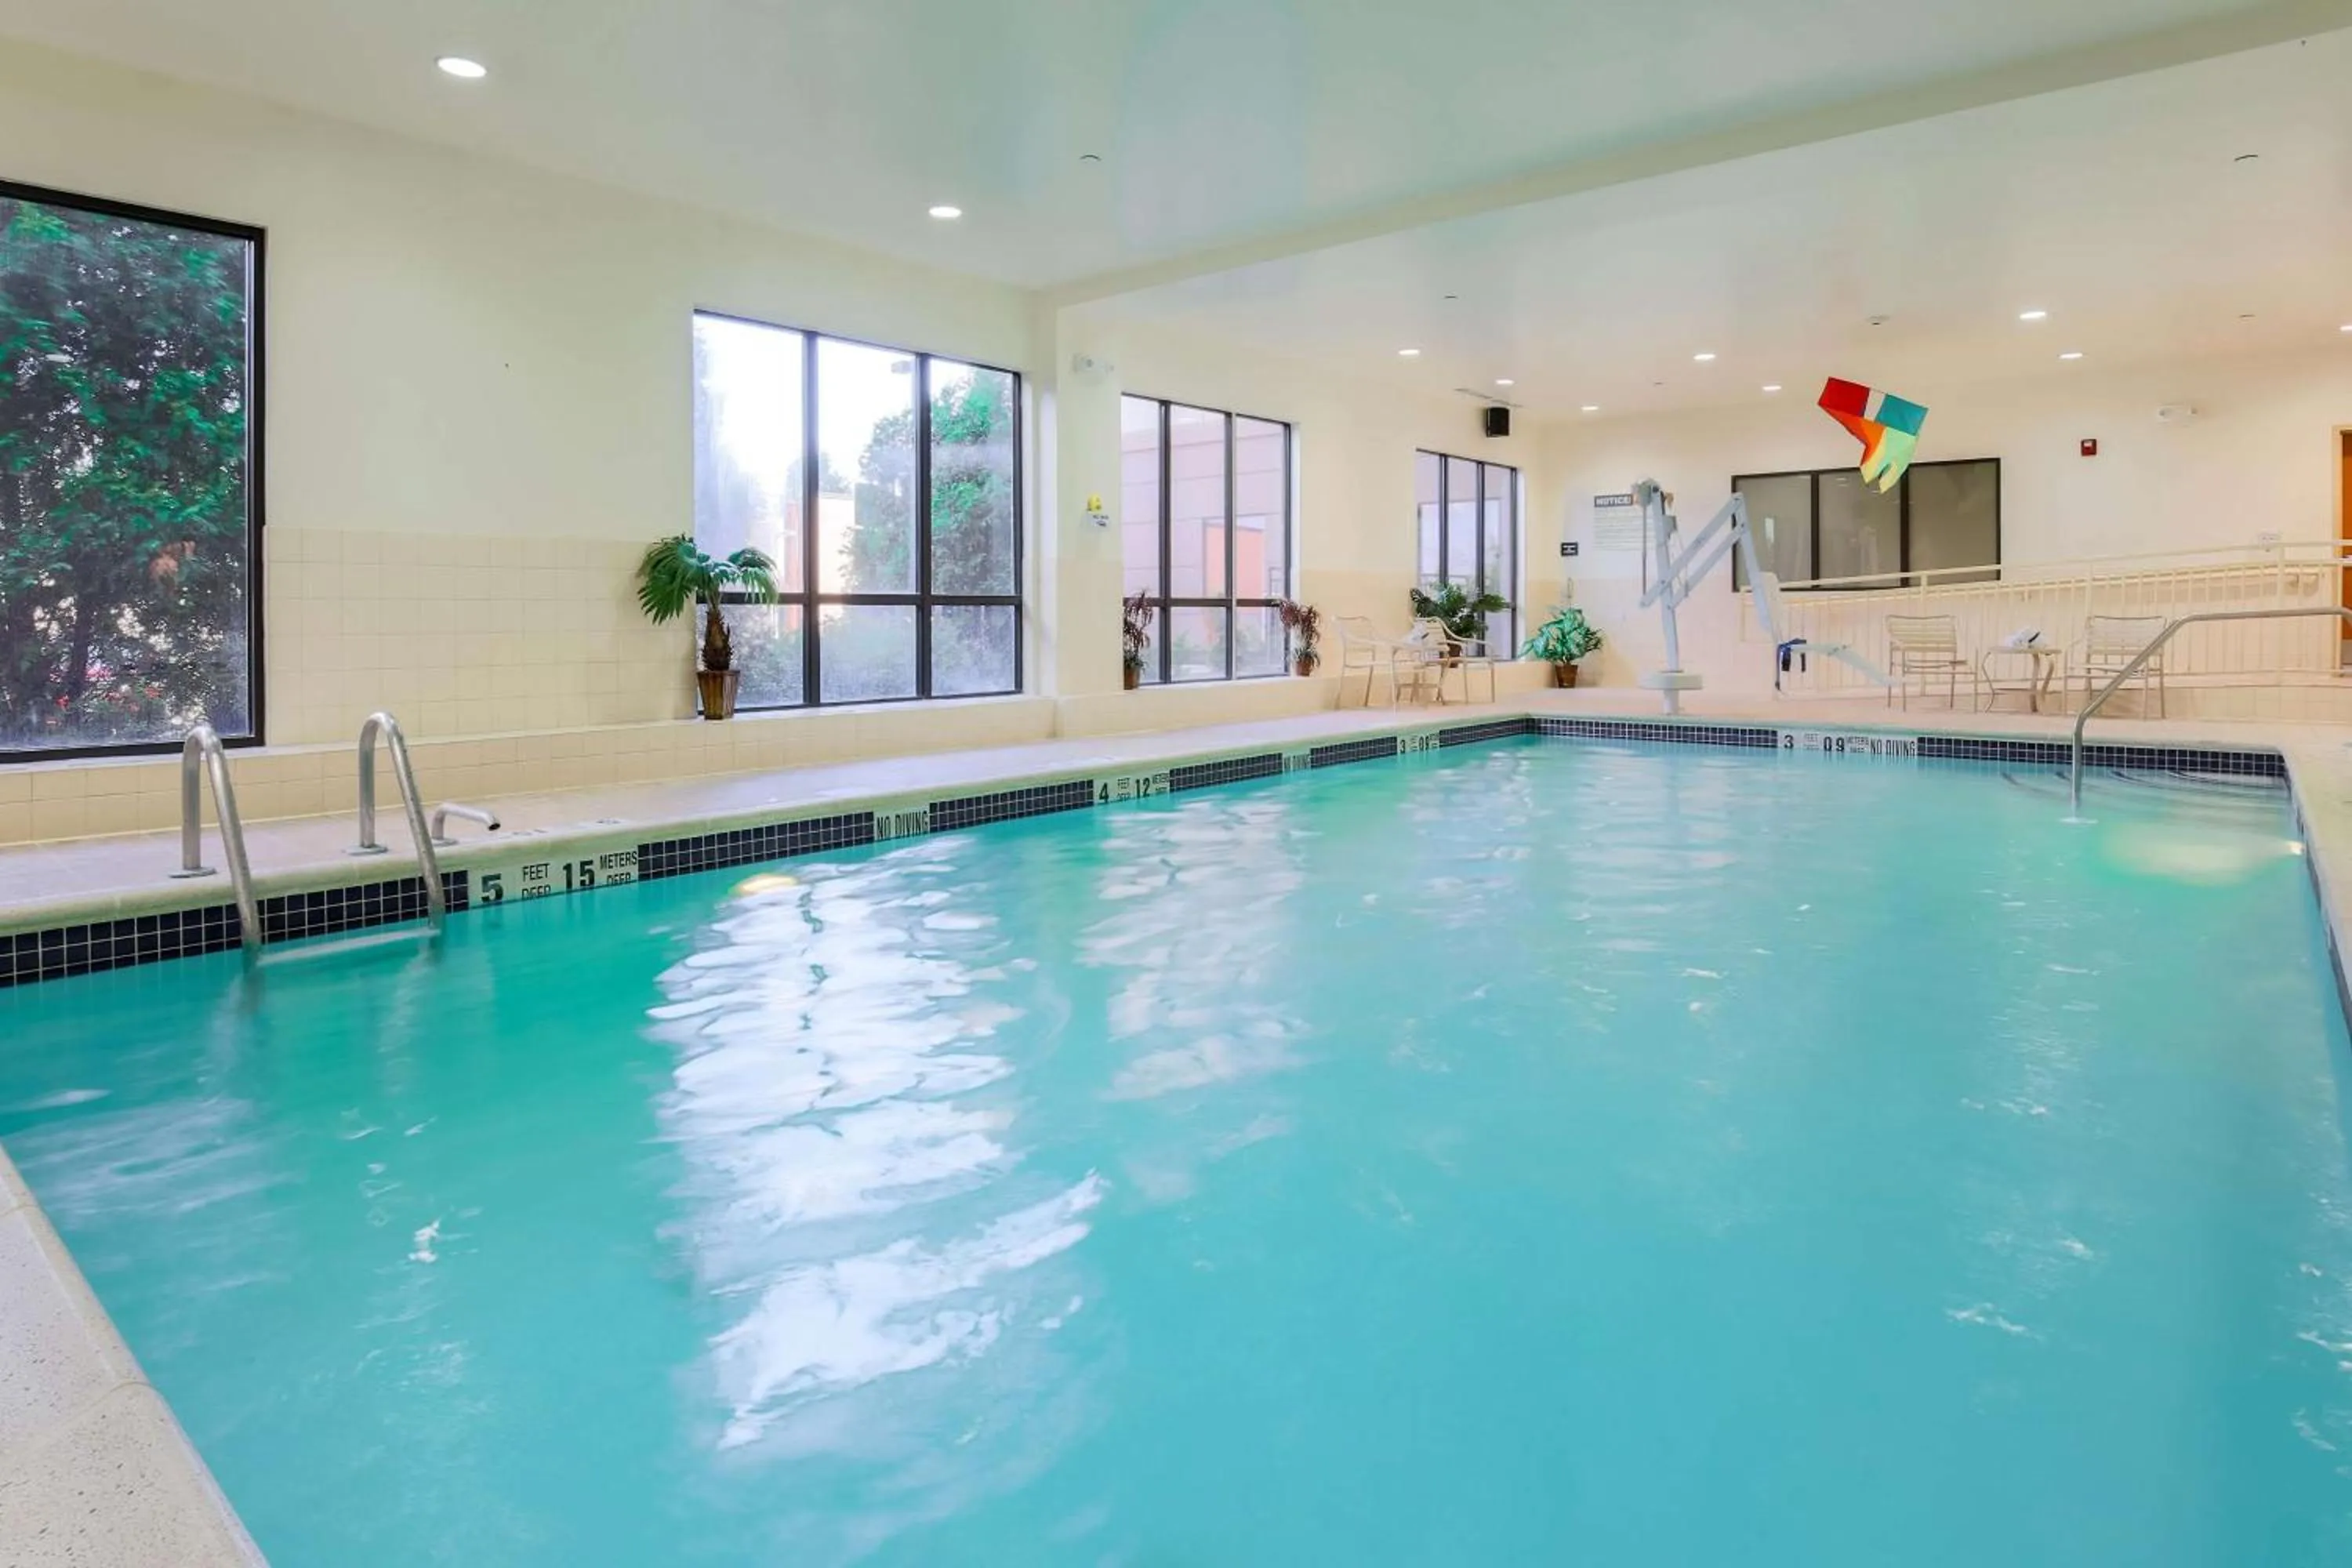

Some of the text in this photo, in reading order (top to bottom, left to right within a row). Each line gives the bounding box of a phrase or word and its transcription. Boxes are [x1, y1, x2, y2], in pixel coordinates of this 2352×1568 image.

[1399, 739, 1406, 753] 3
[1784, 735, 1794, 749] 3
[1871, 739, 1882, 754] NO
[1886, 739, 1915, 757] DIVING
[1099, 782, 1109, 804] 4
[877, 811, 929, 840] NO DIVING
[481, 873, 503, 903] 5
[522, 862, 550, 882] FEET
[600, 851, 637, 870] METERS
